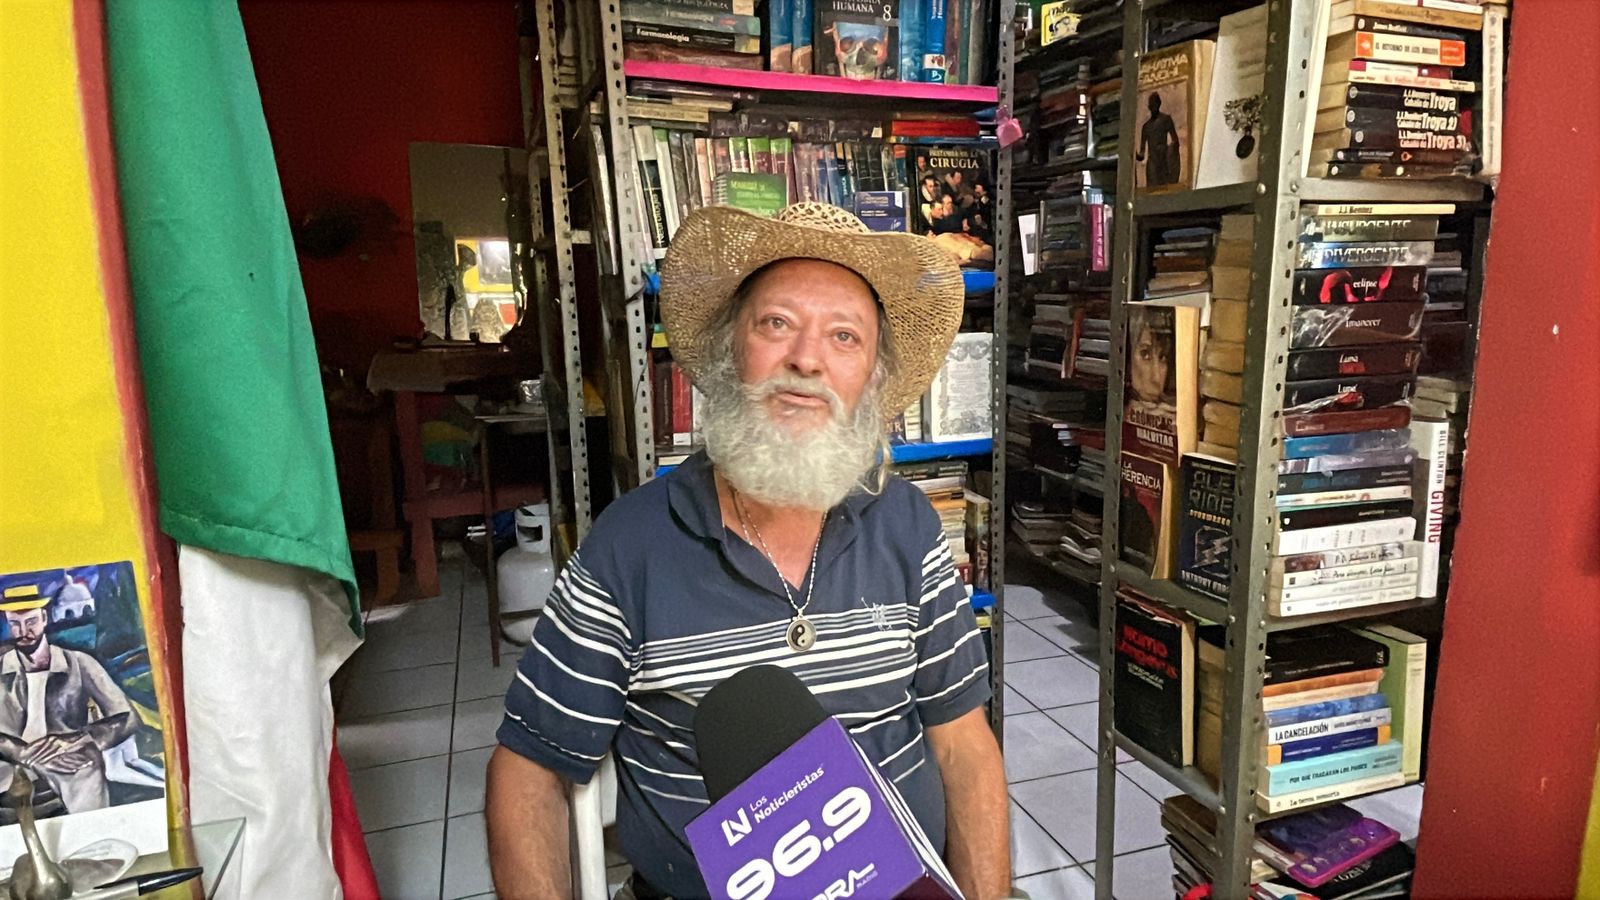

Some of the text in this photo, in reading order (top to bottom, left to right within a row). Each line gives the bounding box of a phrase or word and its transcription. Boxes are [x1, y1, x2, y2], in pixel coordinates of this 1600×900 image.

[832, 1, 874, 13] HUMANA
[882, 4, 892, 21] 8
[1142, 53, 1188, 73] AHATMA
[1430, 92, 1456, 112] Troya
[1422, 112, 1447, 131] Troya
[1427, 132, 1455, 150] Troya
[1324, 247, 1409, 262] DIVERGENTE
[1353, 279, 1378, 294] eclipse
[1339, 353, 1358, 363] Luna
[1337, 383, 1358, 393] Luna
[1122, 460, 1132, 469] LA
[1120, 469, 1161, 490] HERENCIA
[1193, 470, 1232, 494] ALE
[1428, 430, 1447, 543] BILL CLINTON GIVING
[1189, 488, 1232, 512] RIDE
[1275, 731, 1284, 741] LA
[1284, 723, 1329, 740] CANCELACIÓN
[749, 795, 768, 812] Los
[754, 766, 825, 824] Noticieristas
[726, 786, 872, 900] 96.9
